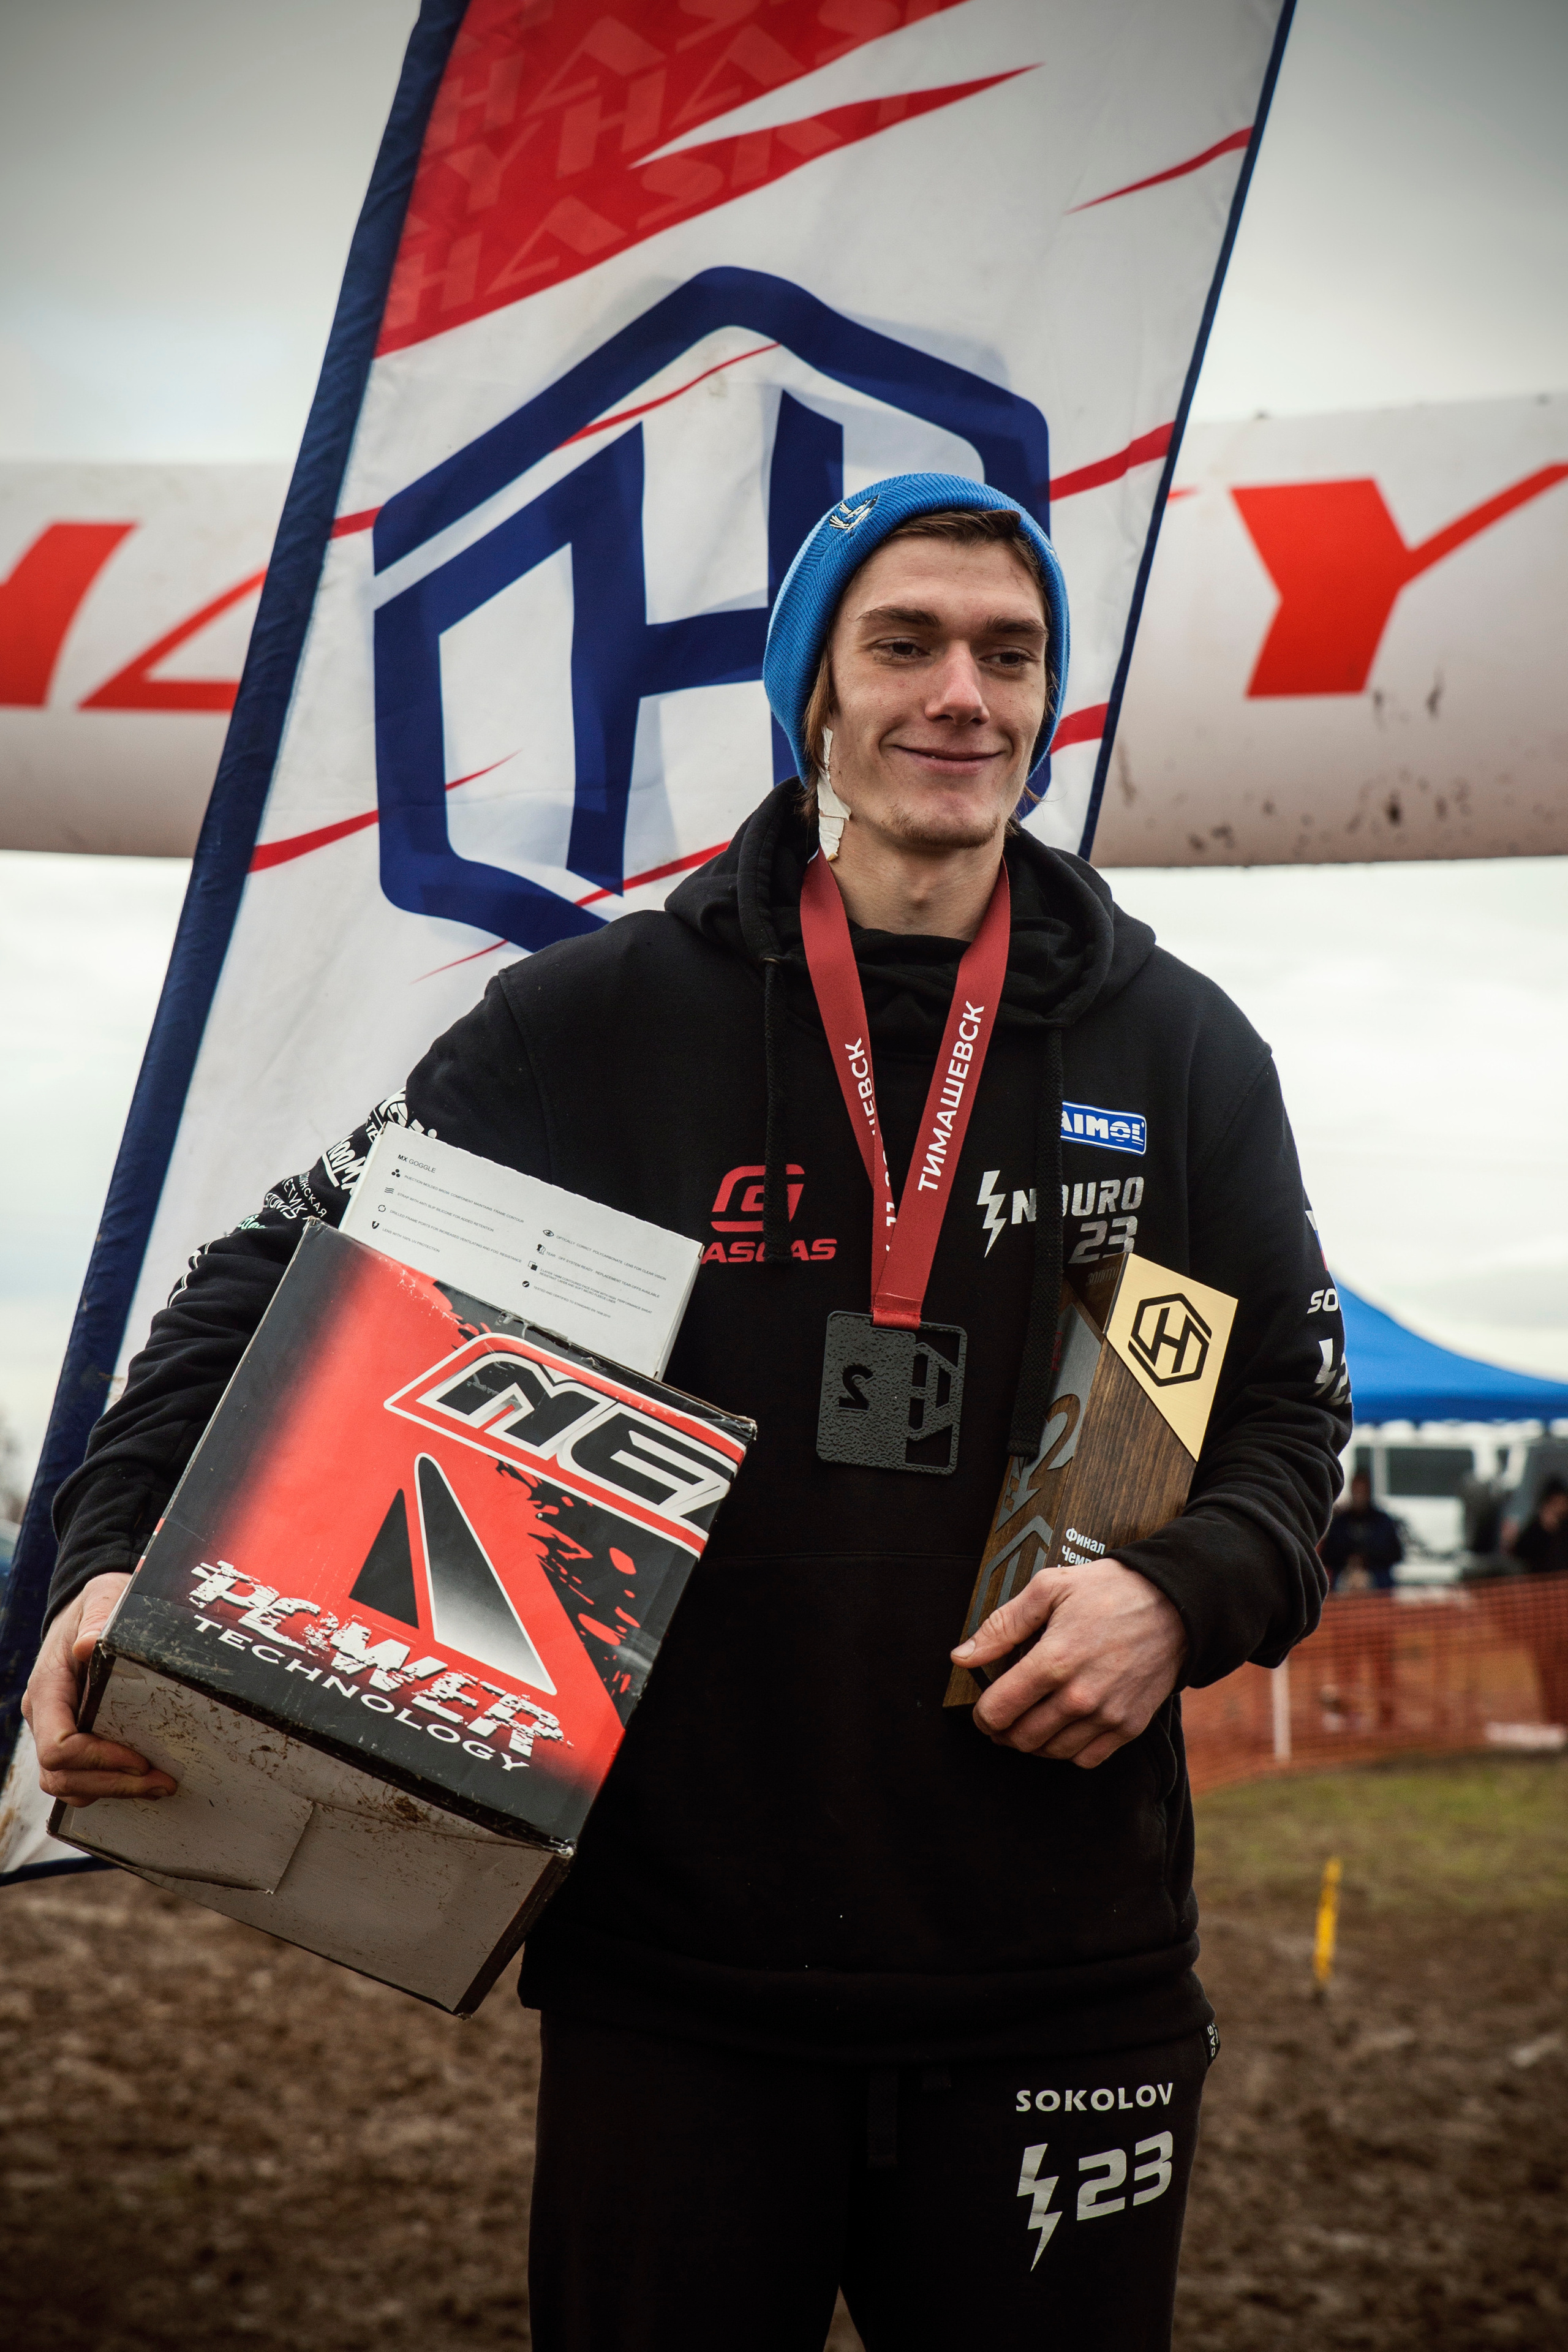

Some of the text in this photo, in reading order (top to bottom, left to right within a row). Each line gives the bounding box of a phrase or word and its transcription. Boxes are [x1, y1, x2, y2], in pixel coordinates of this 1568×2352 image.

[918, 1000, 985, 1191] ТИМАШЕВСК
[409, 1159, 436, 1173] GOGGLE
[404, 1175, 422, 1184] INJECTION
[450, 1193, 473, 1204] COMPONENT
[473, 1201, 492, 1211] MAINTAINS
[506, 1214, 524, 1223] CONTOUR
[435, 1207, 452, 1216] SILICONE
[473, 1222, 494, 1232] RETENTION
[417, 1241, 440, 1252] PROTECTION
[439, 1229, 459, 1238] INCREASED
[459, 1237, 481, 1248] VENTILATING
[499, 1253, 522, 1263] RESISTANCE
[556, 1235, 575, 1245] OPTICALLY
[592, 1250, 622, 1263] POLYCARBONATE
[1067, 1215, 1138, 1264] 23
[562, 1277, 581, 1286] CONTOURED
[617, 1298, 640, 1309] PERFORMANCE
[595, 1270, 621, 1283] REPLACEMENT
[641, 1289, 659, 1297] AVAILABLE
[1306, 1288, 1341, 1314] SO
[1065, 1528, 1106, 1555] Финал
[188, 1559, 573, 1757] POWER
[194, 1614, 530, 1771] TECHNOLOGY
[1016, 2082, 1174, 2112] SOKOLOV
[1076, 2130, 1174, 2221] 23
